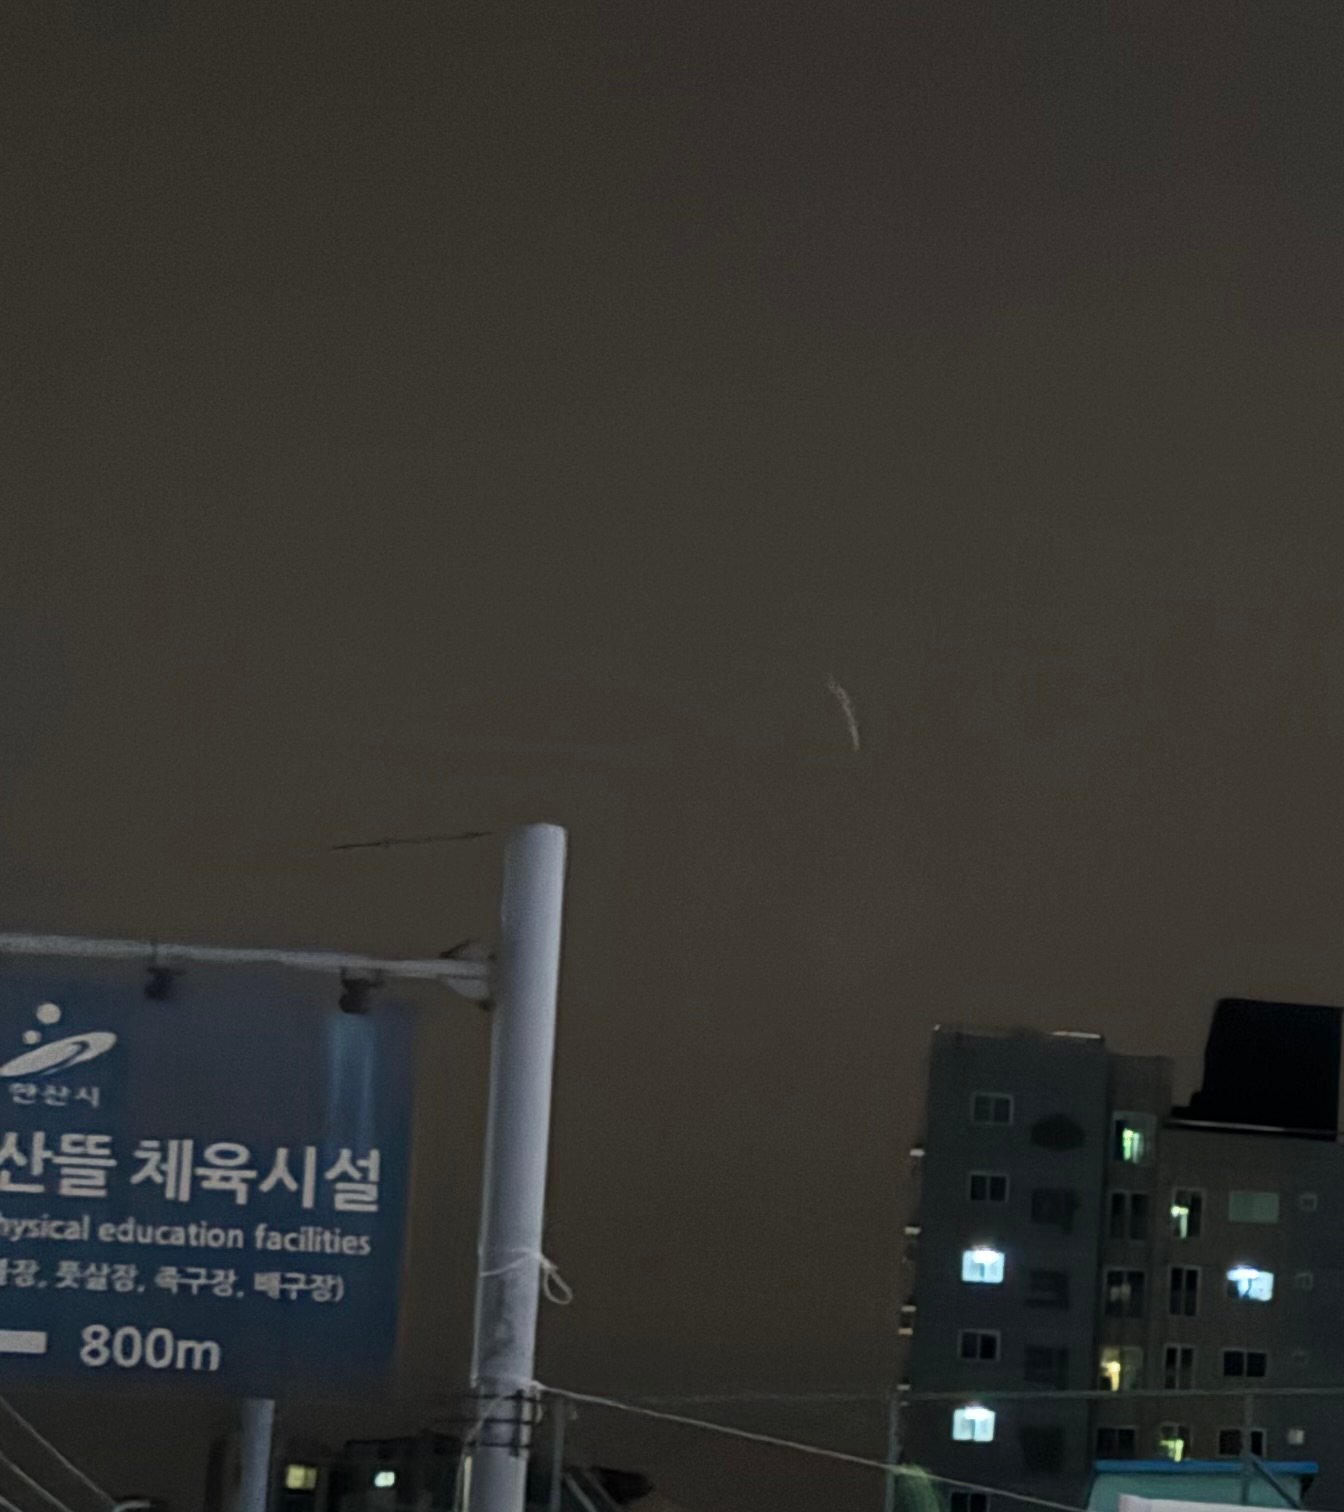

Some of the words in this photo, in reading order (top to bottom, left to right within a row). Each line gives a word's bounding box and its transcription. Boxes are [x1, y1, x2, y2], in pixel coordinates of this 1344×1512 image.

[131, 1138, 381, 1212] 체육시설
[98, 1220, 243, 1249] education
[255, 1224, 371, 1256] facilities
[79, 1325, 220, 1371] 800m
